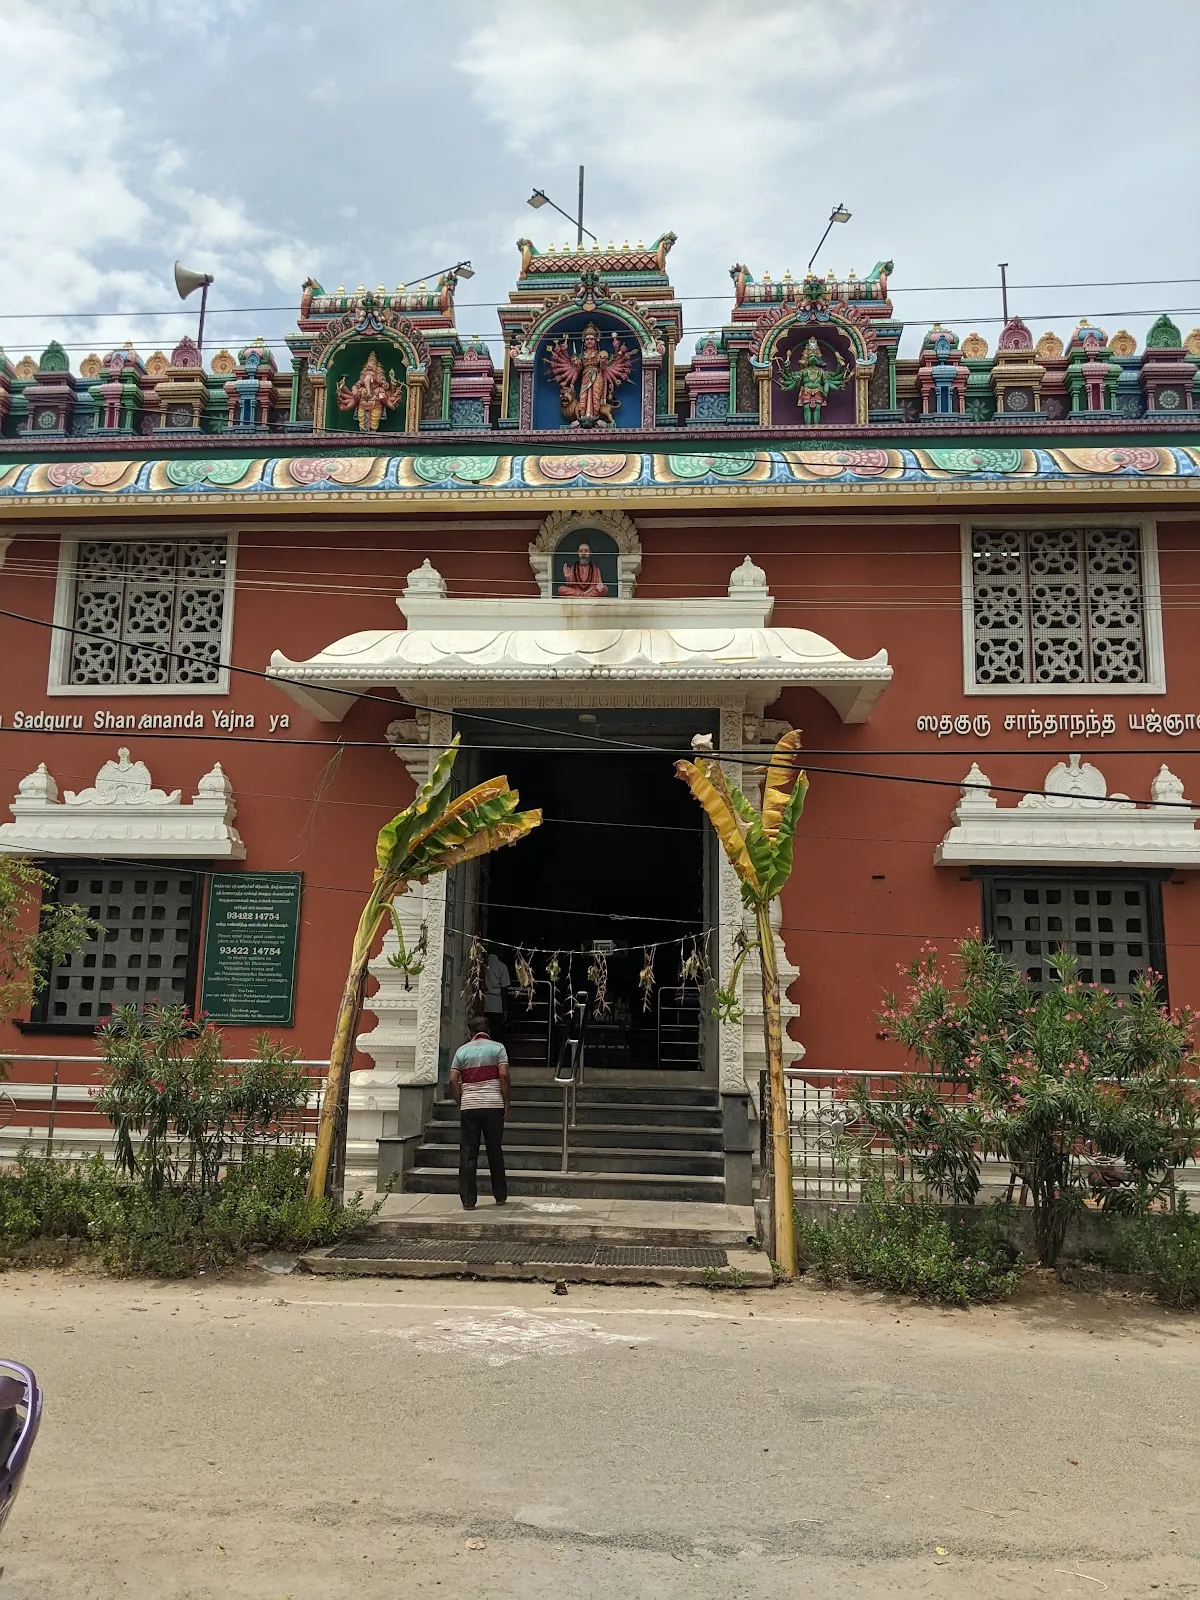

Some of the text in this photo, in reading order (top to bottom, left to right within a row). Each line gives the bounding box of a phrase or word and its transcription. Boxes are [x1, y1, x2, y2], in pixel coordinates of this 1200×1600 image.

[13, 710, 83, 731] Sadguru
[211, 709, 255, 733] Yajna
[268, 714, 290, 733] ya
[1003, 708, 1116, 739] சாந்தாநந்த
[226, 911, 280, 921] 93422 14754
[219, 946, 282, 956] 93422 14754
